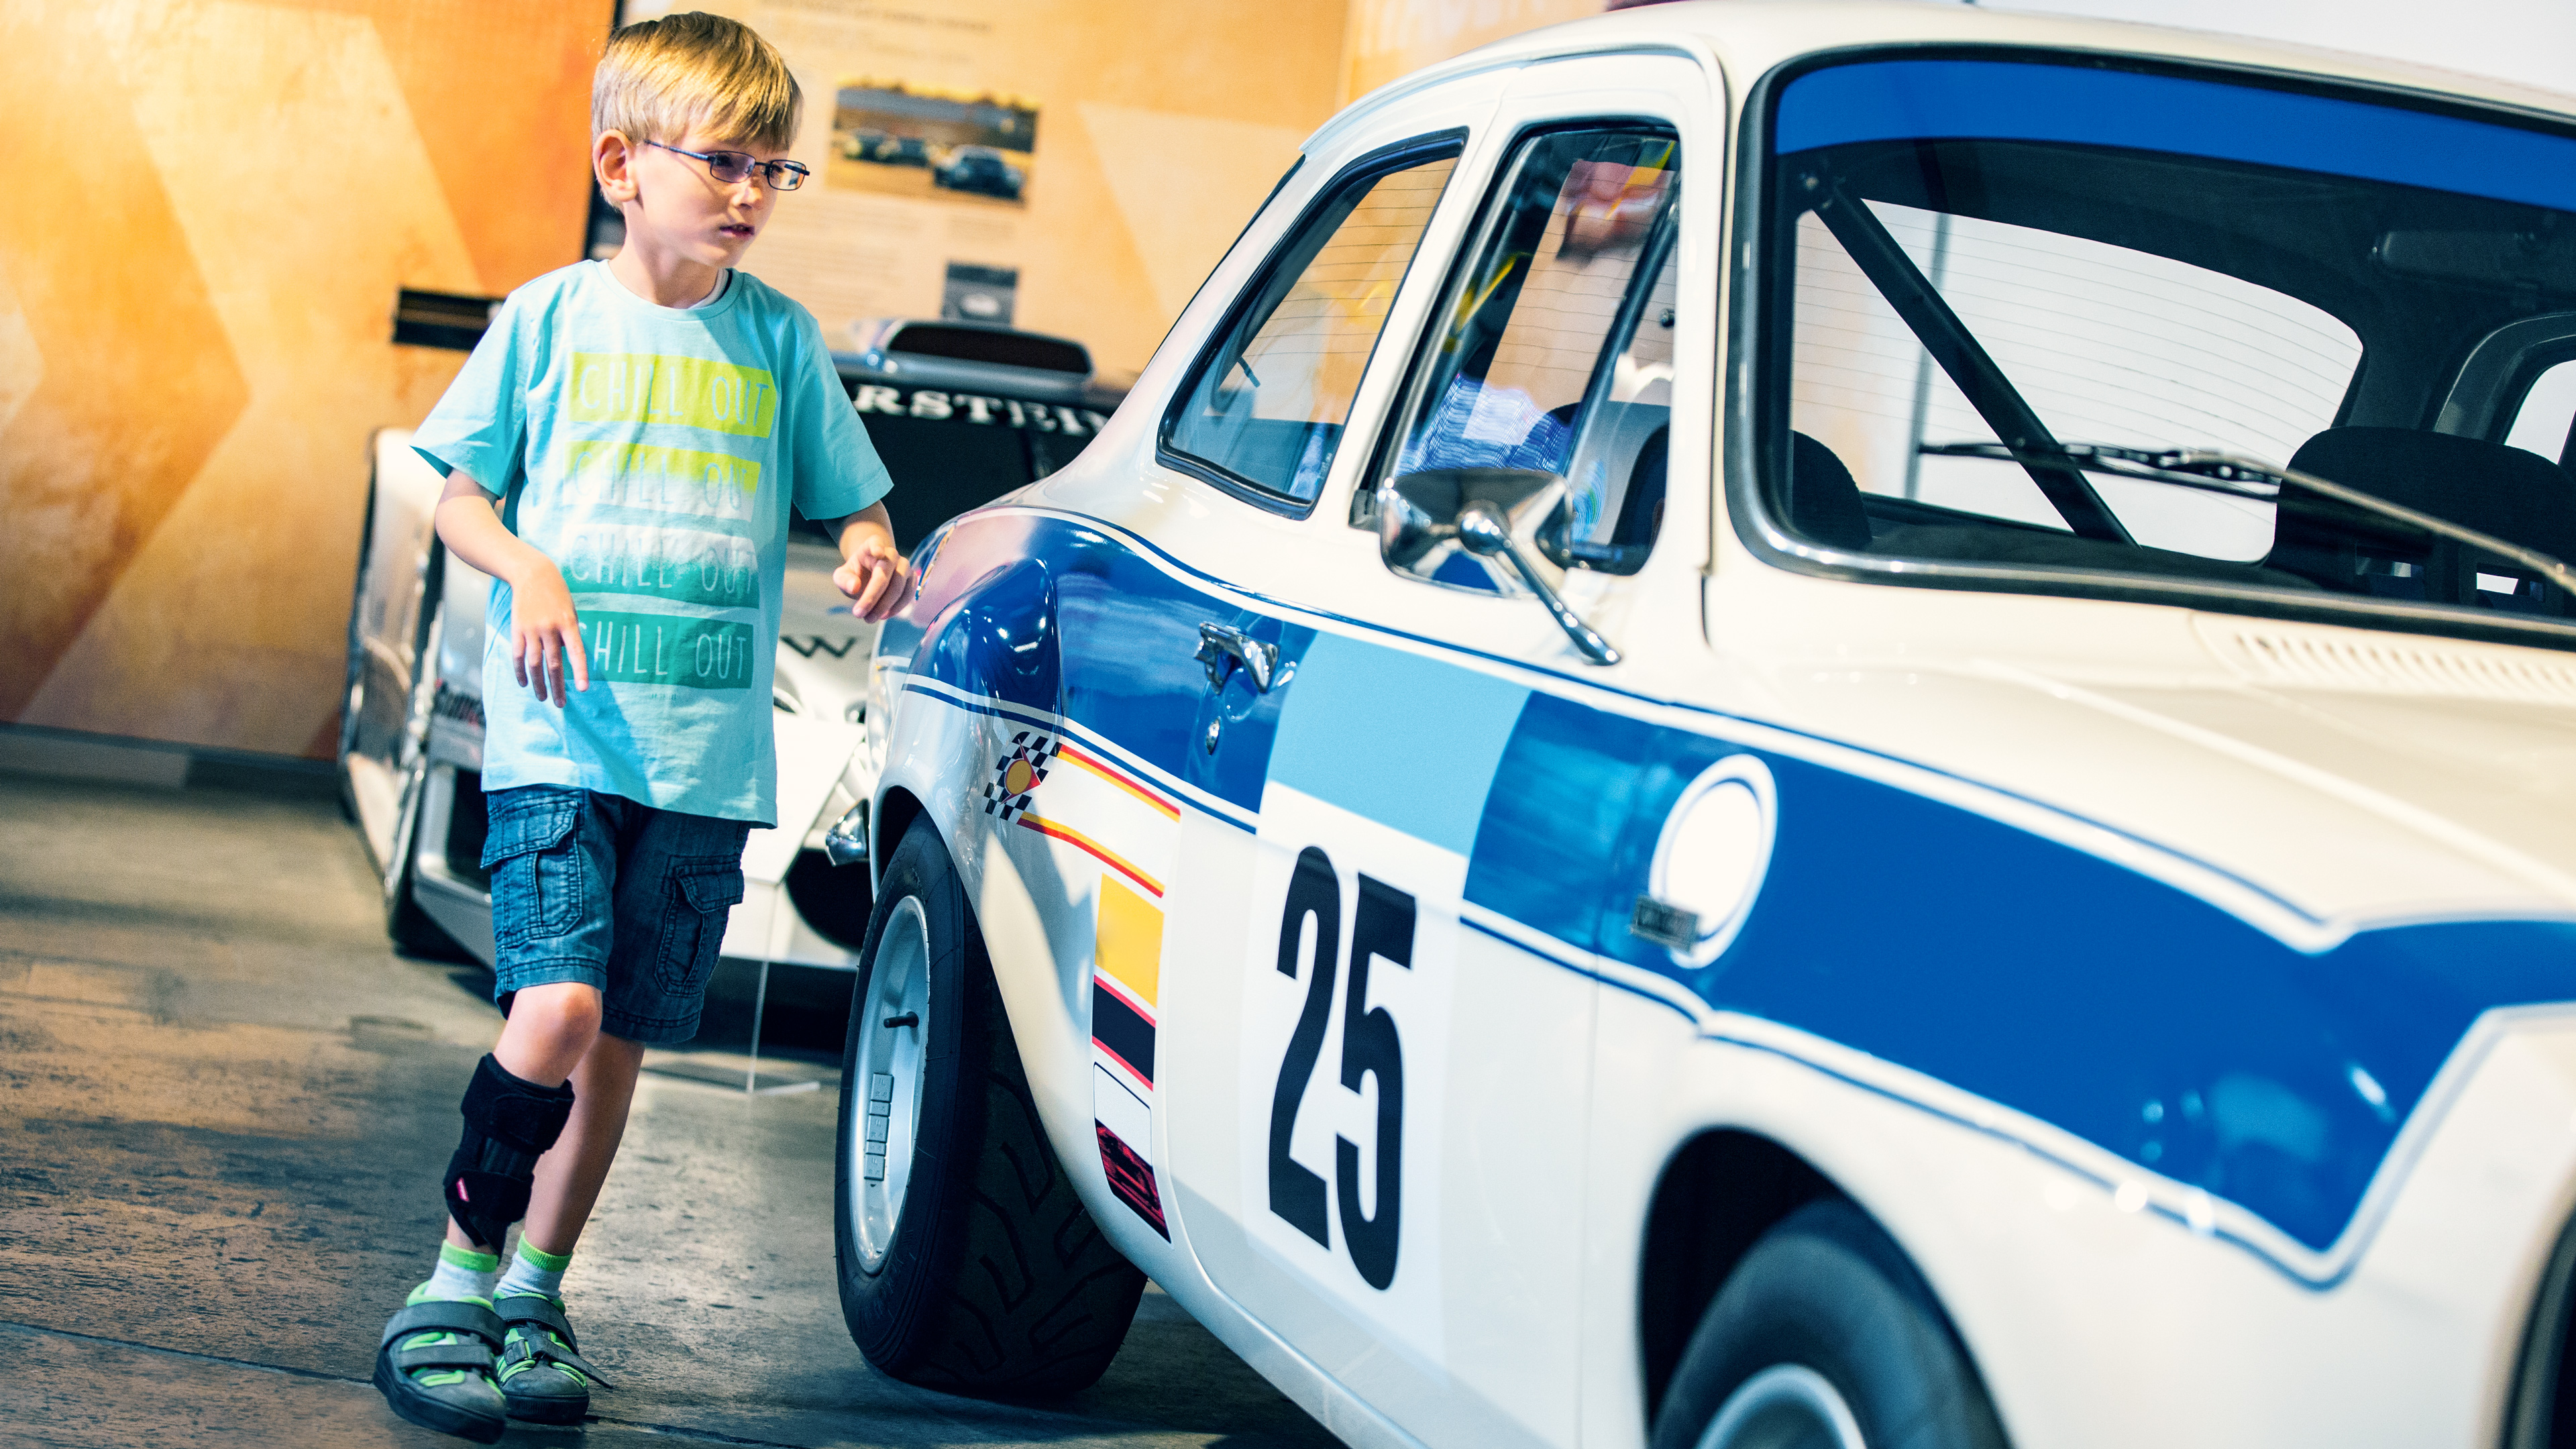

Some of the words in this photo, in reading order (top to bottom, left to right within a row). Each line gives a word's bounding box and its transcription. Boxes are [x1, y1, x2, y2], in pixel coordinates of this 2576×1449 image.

[580, 362, 683, 417] CHILL
[711, 376, 769, 427] OUT
[574, 449, 674, 504] CHILL
[570, 533, 672, 588] CHILL
[702, 547, 757, 594] OUT
[696, 634, 746, 679] OUT
[1269, 845, 1418, 1291] 25
